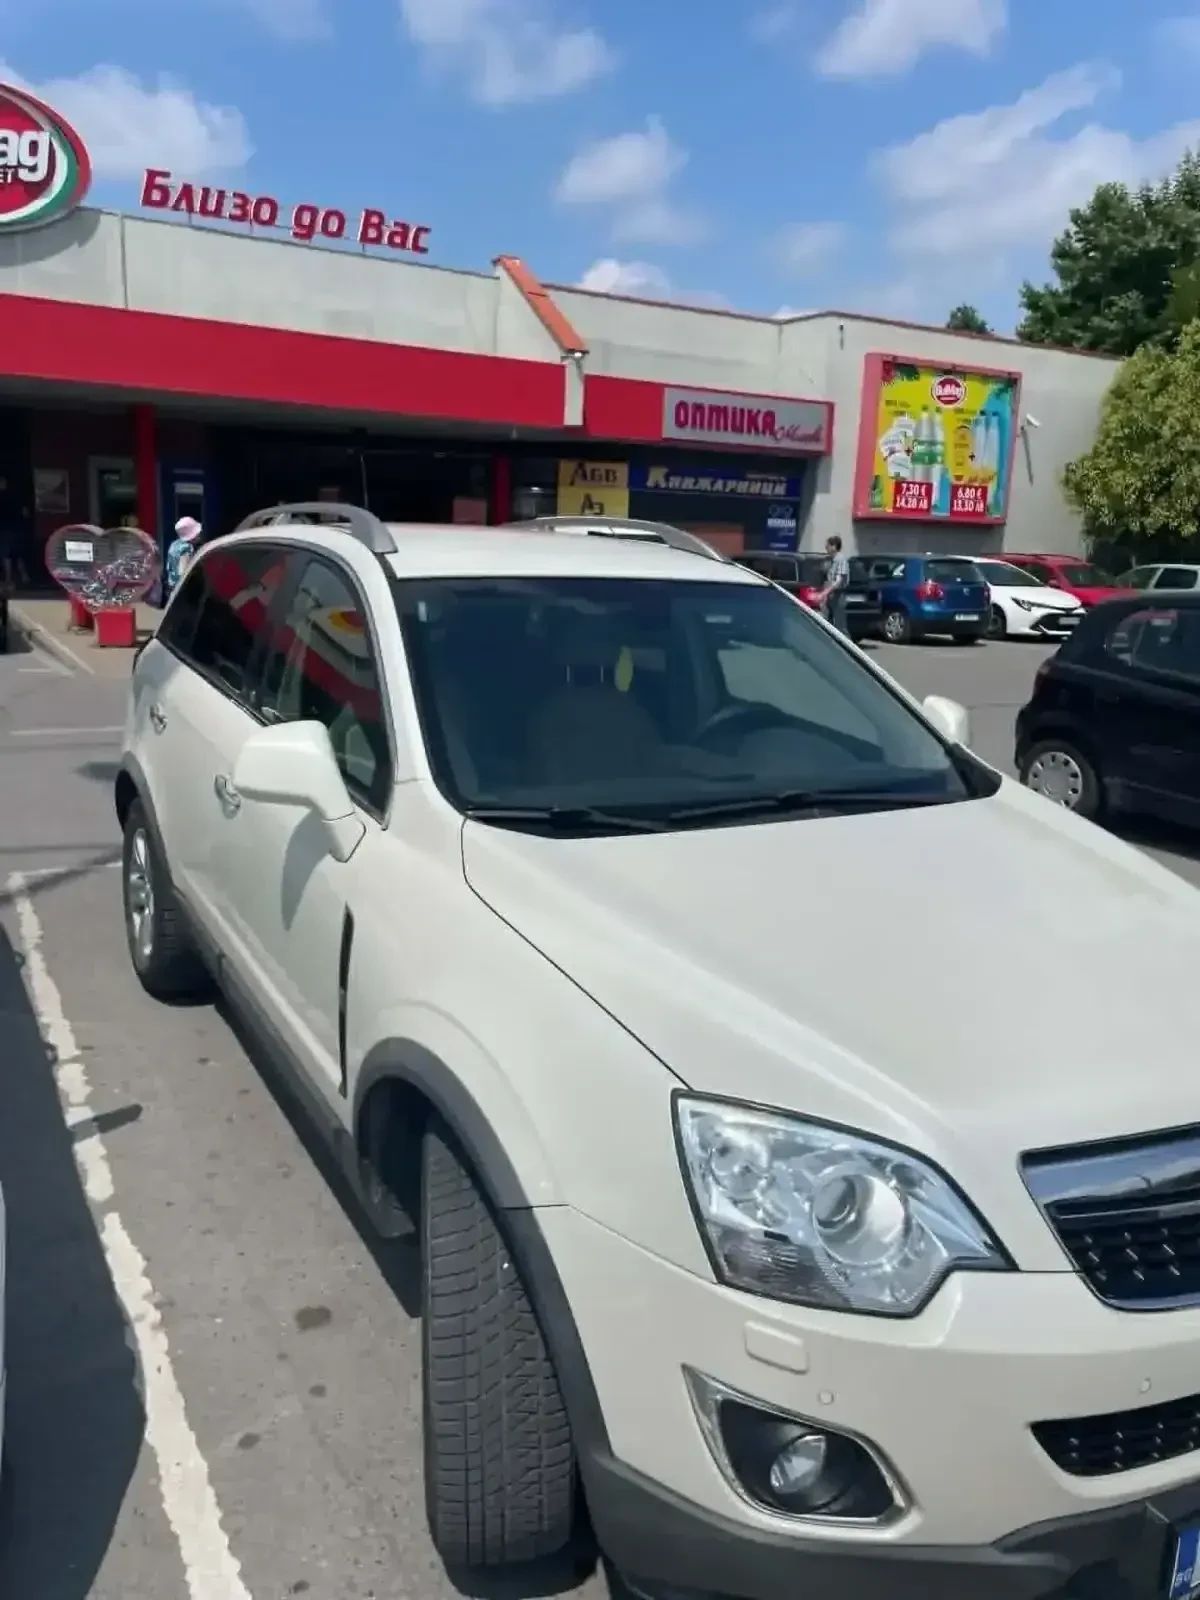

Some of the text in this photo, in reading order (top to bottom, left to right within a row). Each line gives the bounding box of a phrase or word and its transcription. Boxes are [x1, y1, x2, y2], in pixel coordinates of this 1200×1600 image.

[141, 168, 432, 254] Близо до Вас
